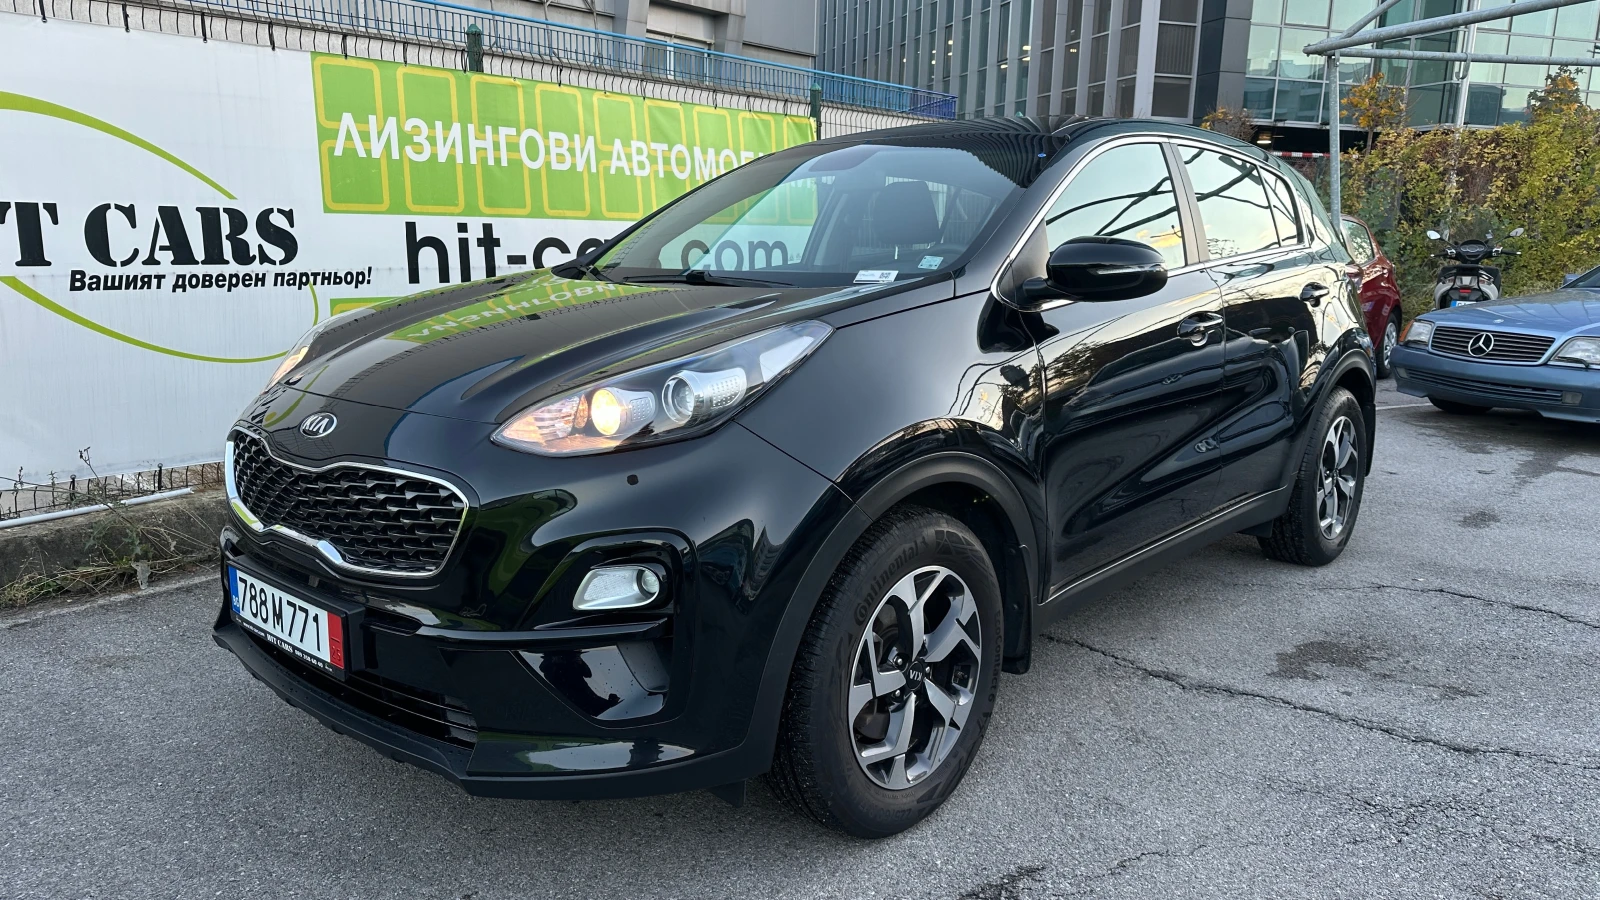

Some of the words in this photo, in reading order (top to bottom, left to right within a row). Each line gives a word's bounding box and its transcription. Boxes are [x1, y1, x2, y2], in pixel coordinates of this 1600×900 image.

[334, 112, 598, 173] ЛИЗИНГОВИ
[610, 139, 764, 181] АВТОМО
[84, 202, 299, 267] CARS
[69, 269, 166, 292] Вашият
[172, 269, 267, 293] доверен
[273, 266, 373, 291] партньор!
[303, 415, 330, 434] KIA
[854, 540, 919, 626] Continental
[909, 669, 923, 682] KIA
